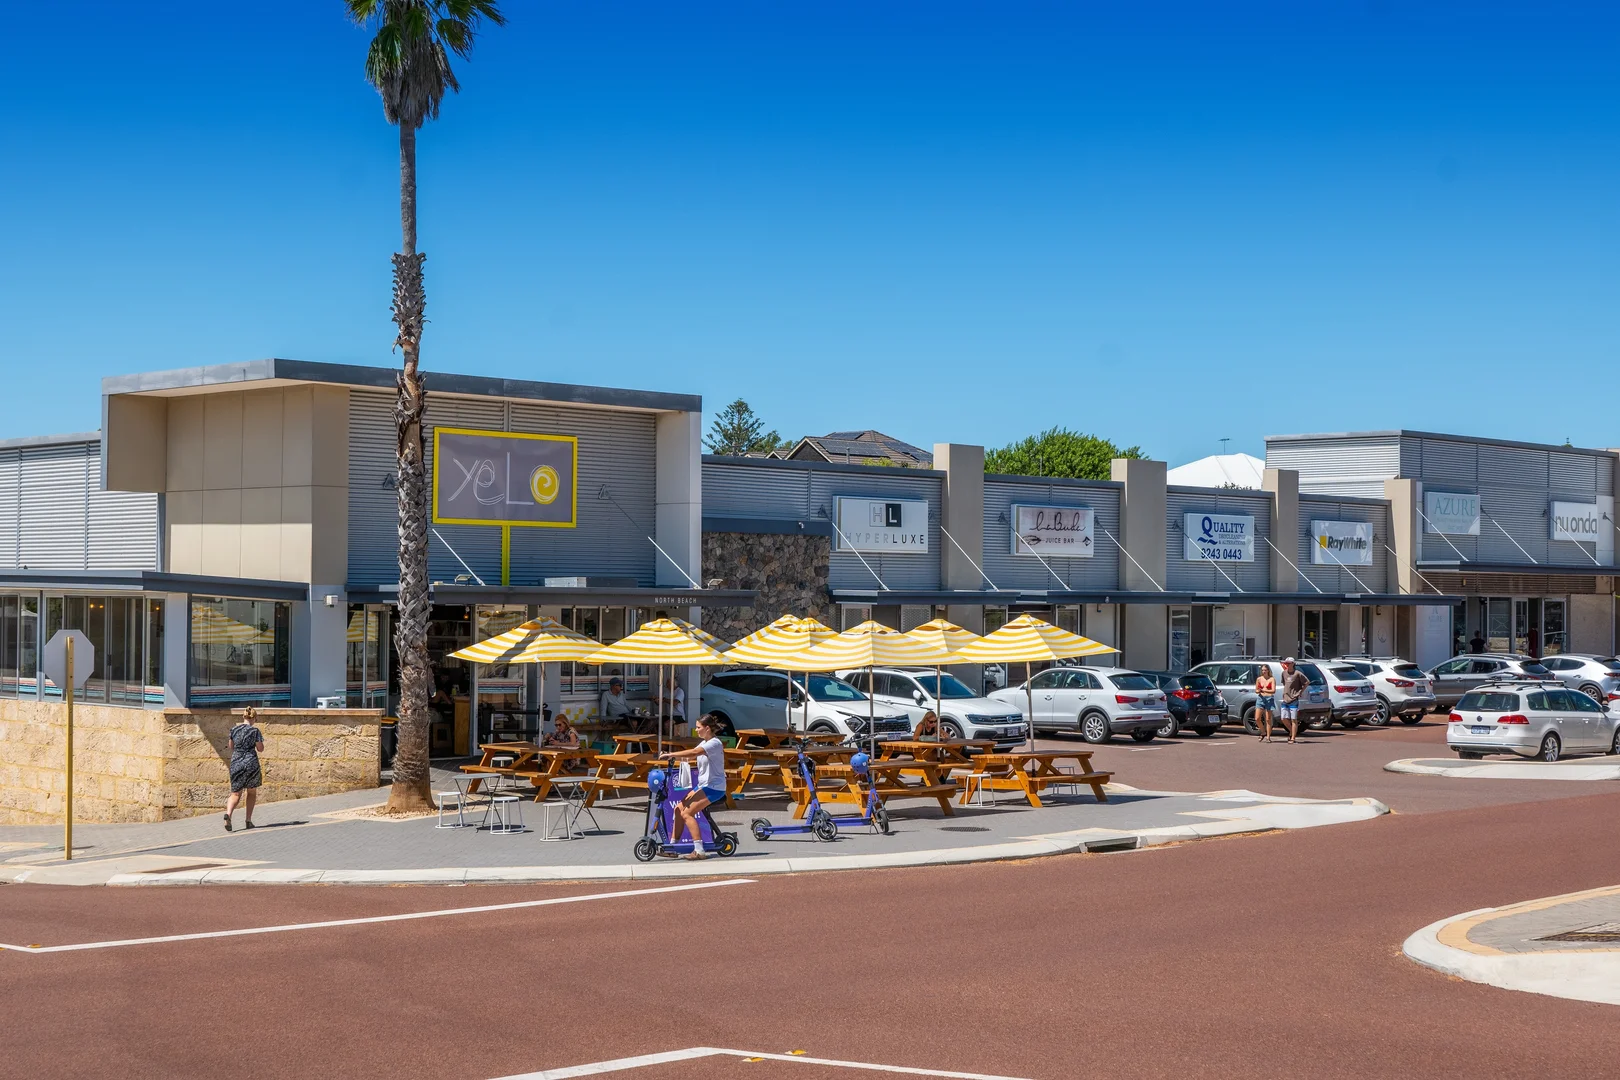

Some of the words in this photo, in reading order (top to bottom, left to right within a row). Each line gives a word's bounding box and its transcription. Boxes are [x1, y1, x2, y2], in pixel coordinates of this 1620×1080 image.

[1434, 498, 1476, 517] AZURE
[1201, 516, 1245, 538] QUALITY
[1570, 511, 1598, 534] onda
[845, 532, 925, 544] HYPERLUXE
[1222, 548, 1242, 560] 0443
